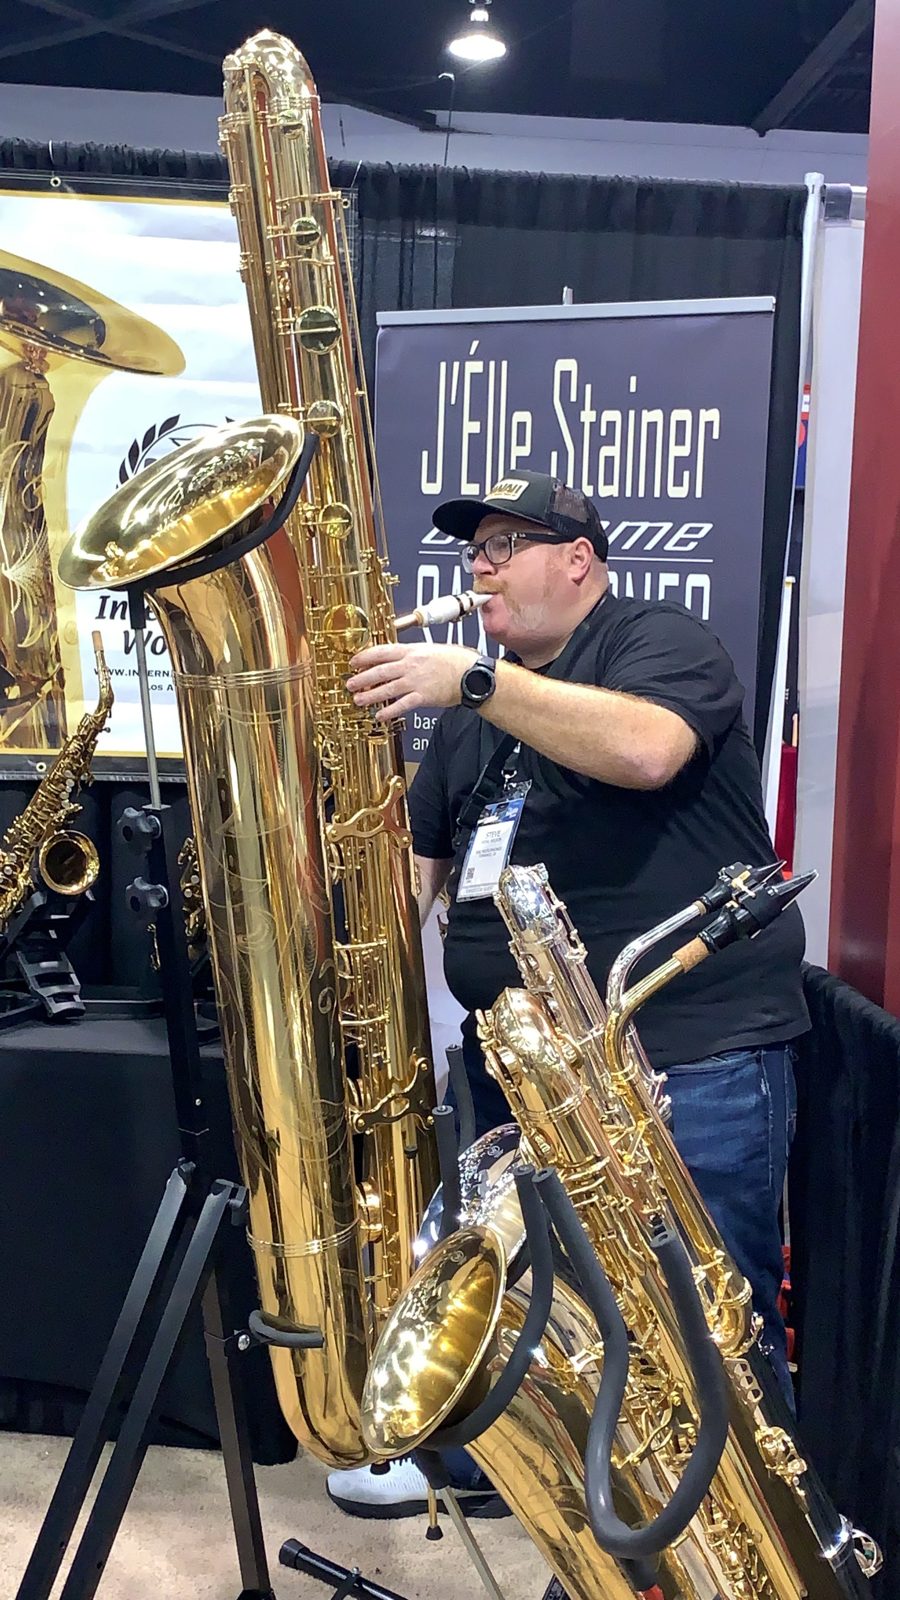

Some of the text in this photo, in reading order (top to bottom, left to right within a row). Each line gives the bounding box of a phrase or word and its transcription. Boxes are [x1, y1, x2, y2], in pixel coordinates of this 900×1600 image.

[551, 358, 721, 499] Stainer
[413, 712, 438, 730] bas
[412, 737, 430, 751] an
